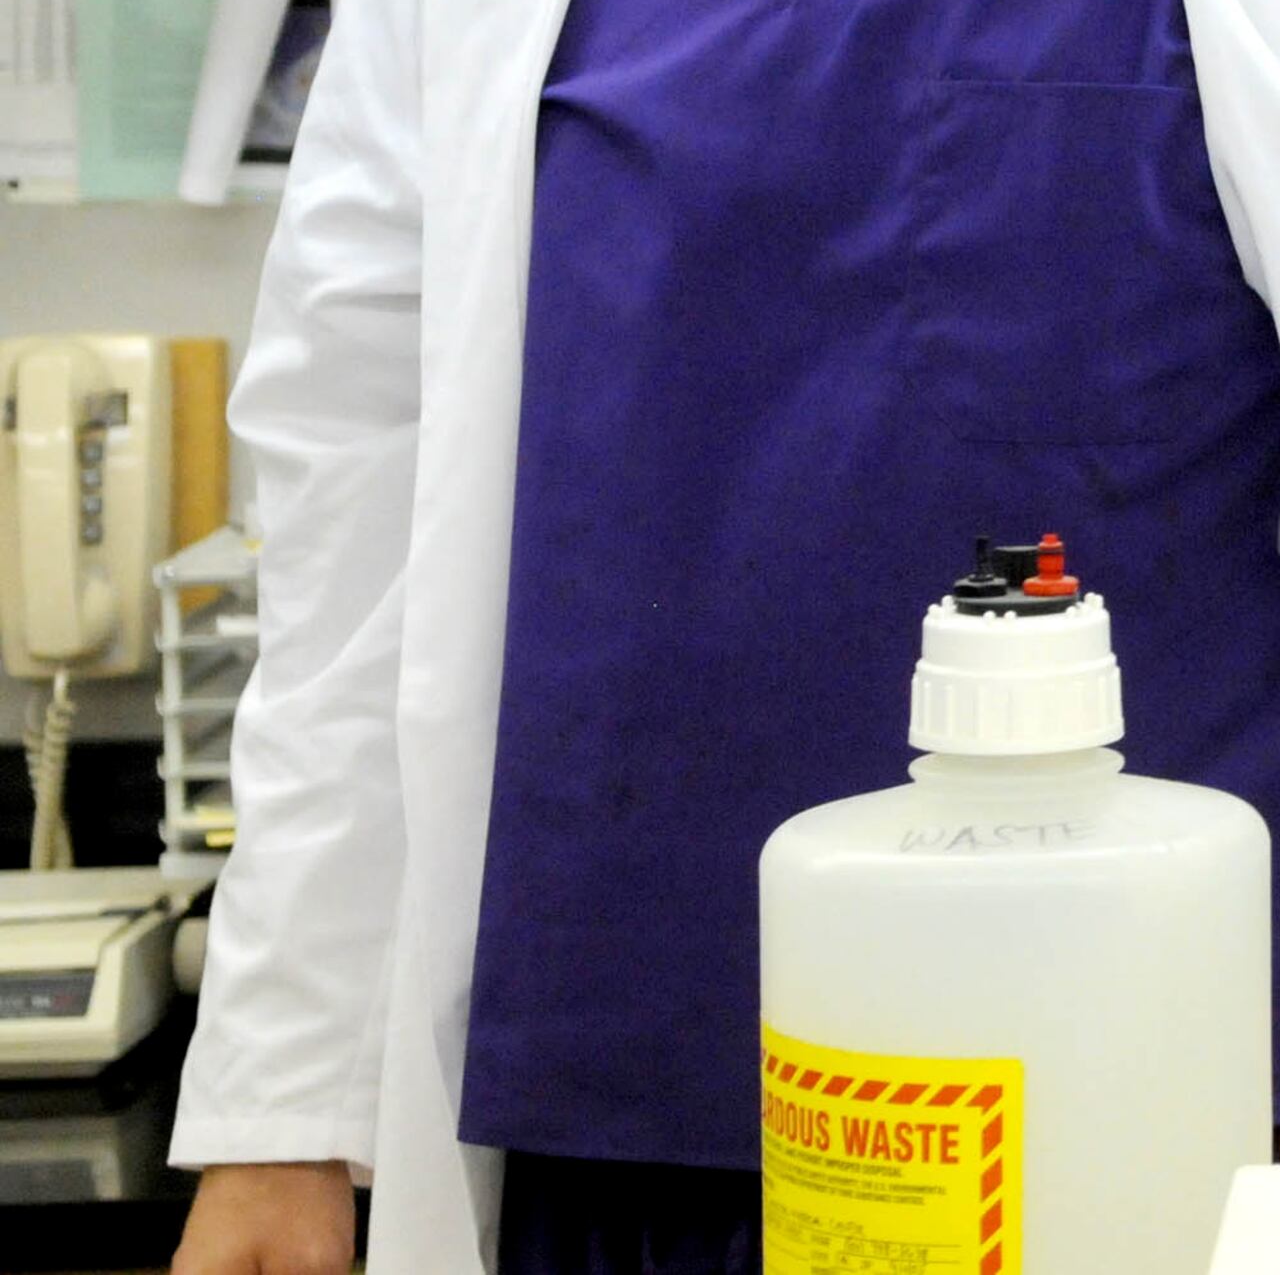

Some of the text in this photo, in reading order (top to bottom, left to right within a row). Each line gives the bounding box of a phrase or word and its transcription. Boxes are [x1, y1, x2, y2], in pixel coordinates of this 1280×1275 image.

[899, 820, 1097, 853] WASTE
[763, 1090, 830, 1152] RDOUS
[840, 1115, 960, 1165] WASTE
